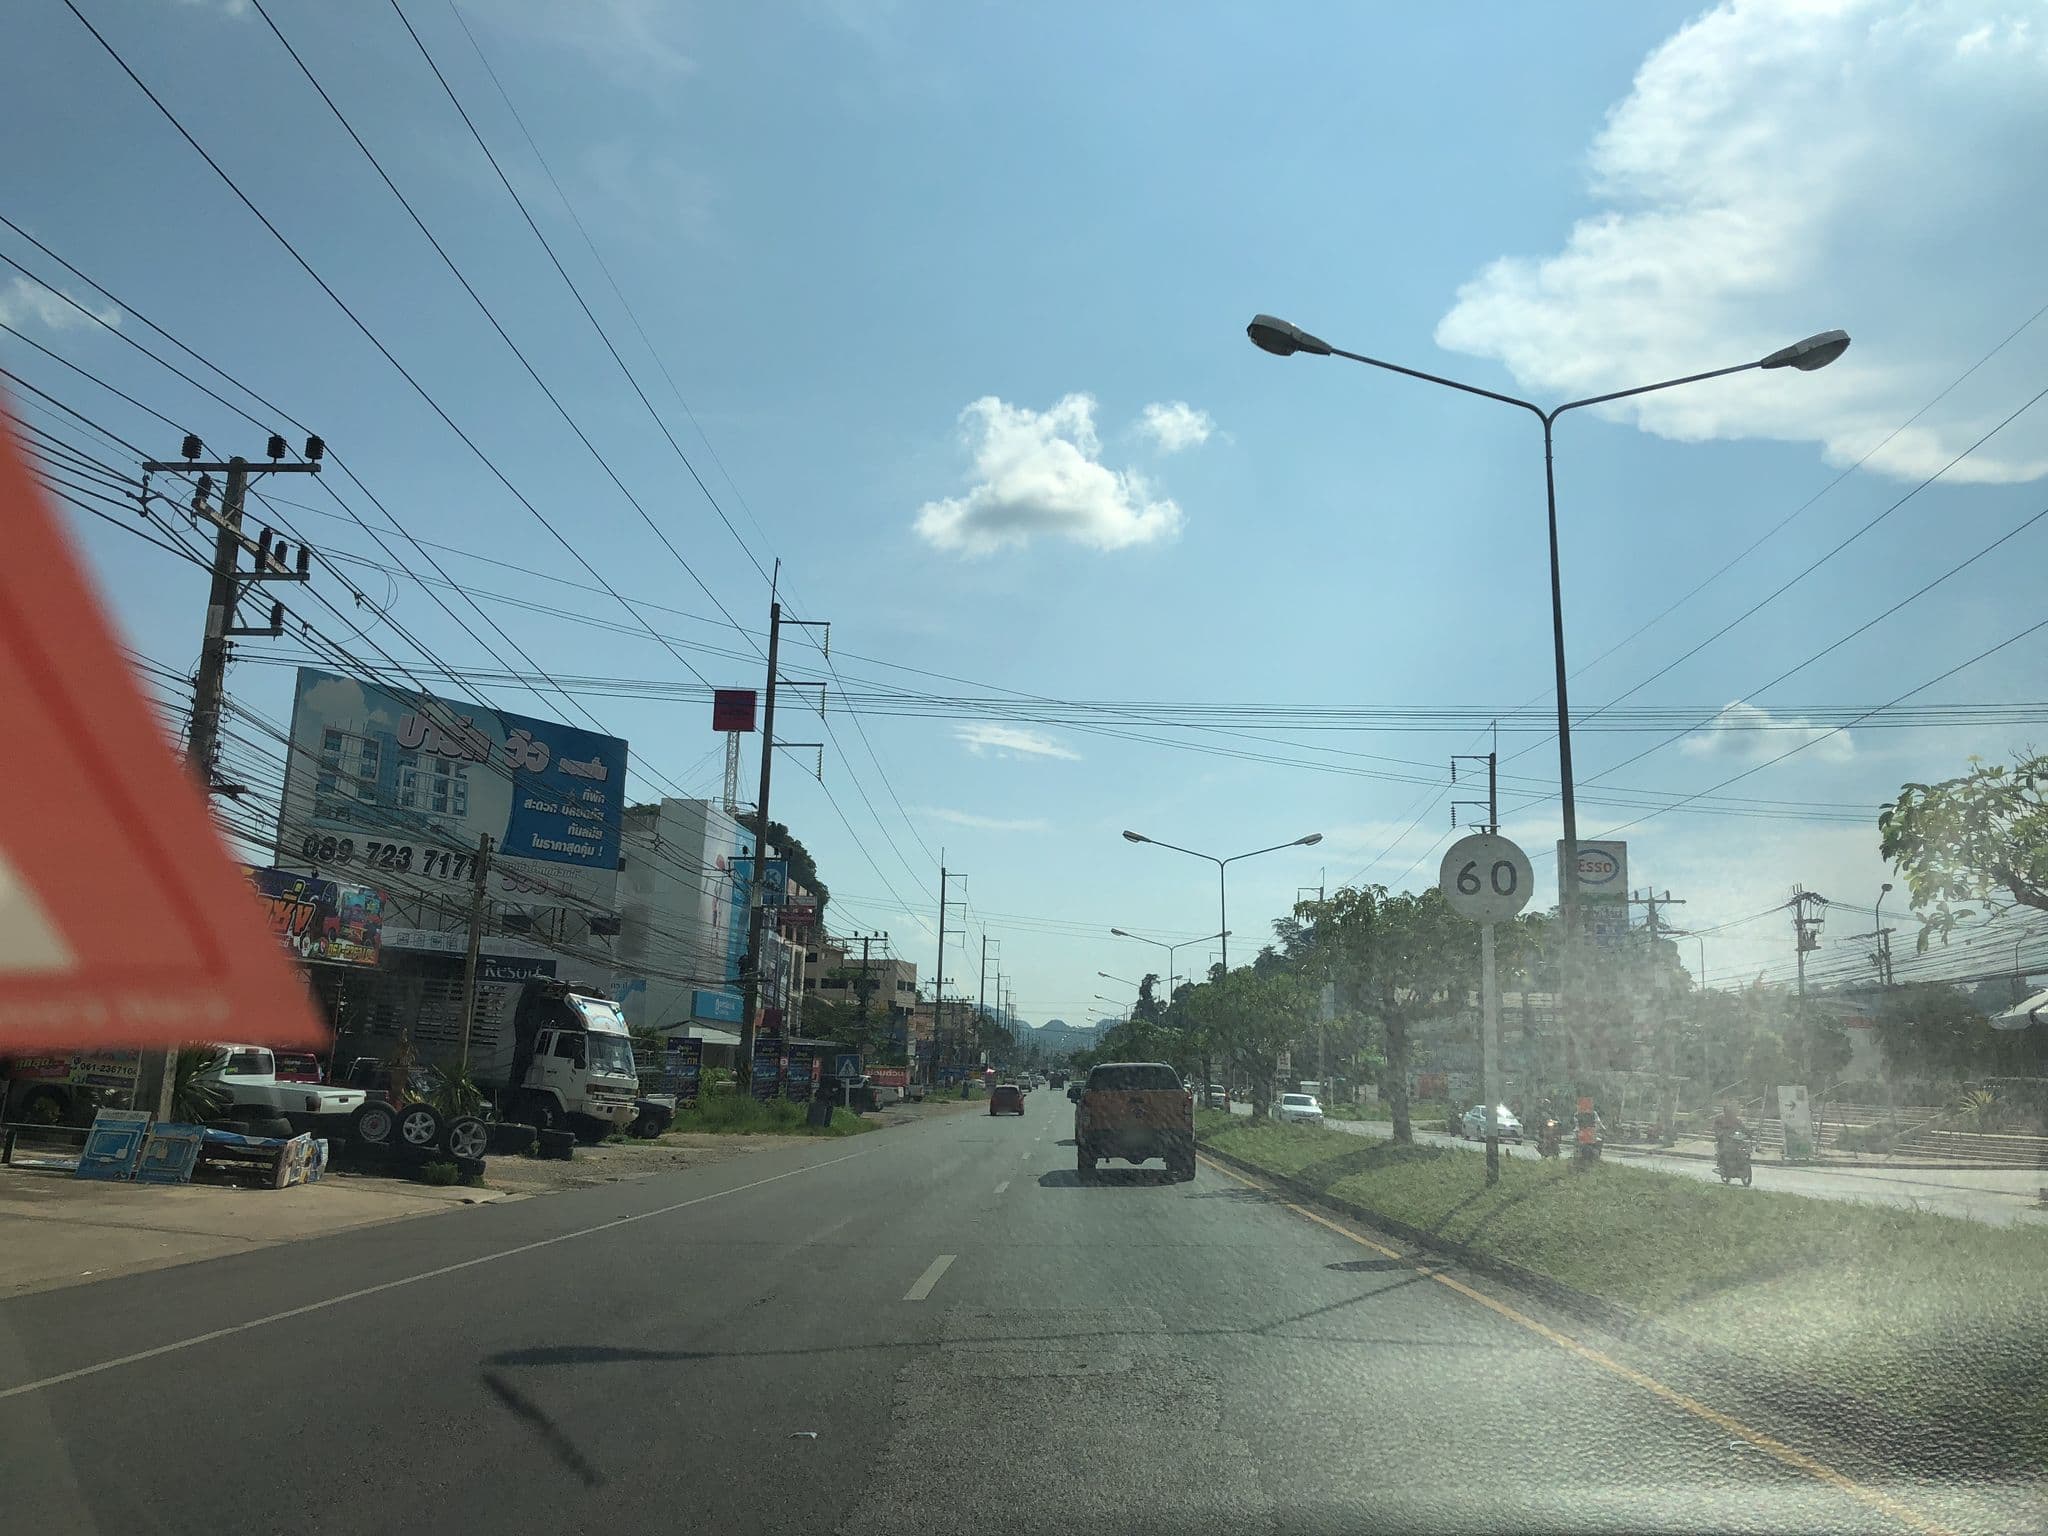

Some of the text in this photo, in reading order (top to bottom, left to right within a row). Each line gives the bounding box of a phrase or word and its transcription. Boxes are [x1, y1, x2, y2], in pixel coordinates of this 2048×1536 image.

[524, 798, 557, 813] สะดวก
[303, 834, 355, 866] 089
[366, 842, 414, 873] 723
[1457, 860, 1517, 896] 60
